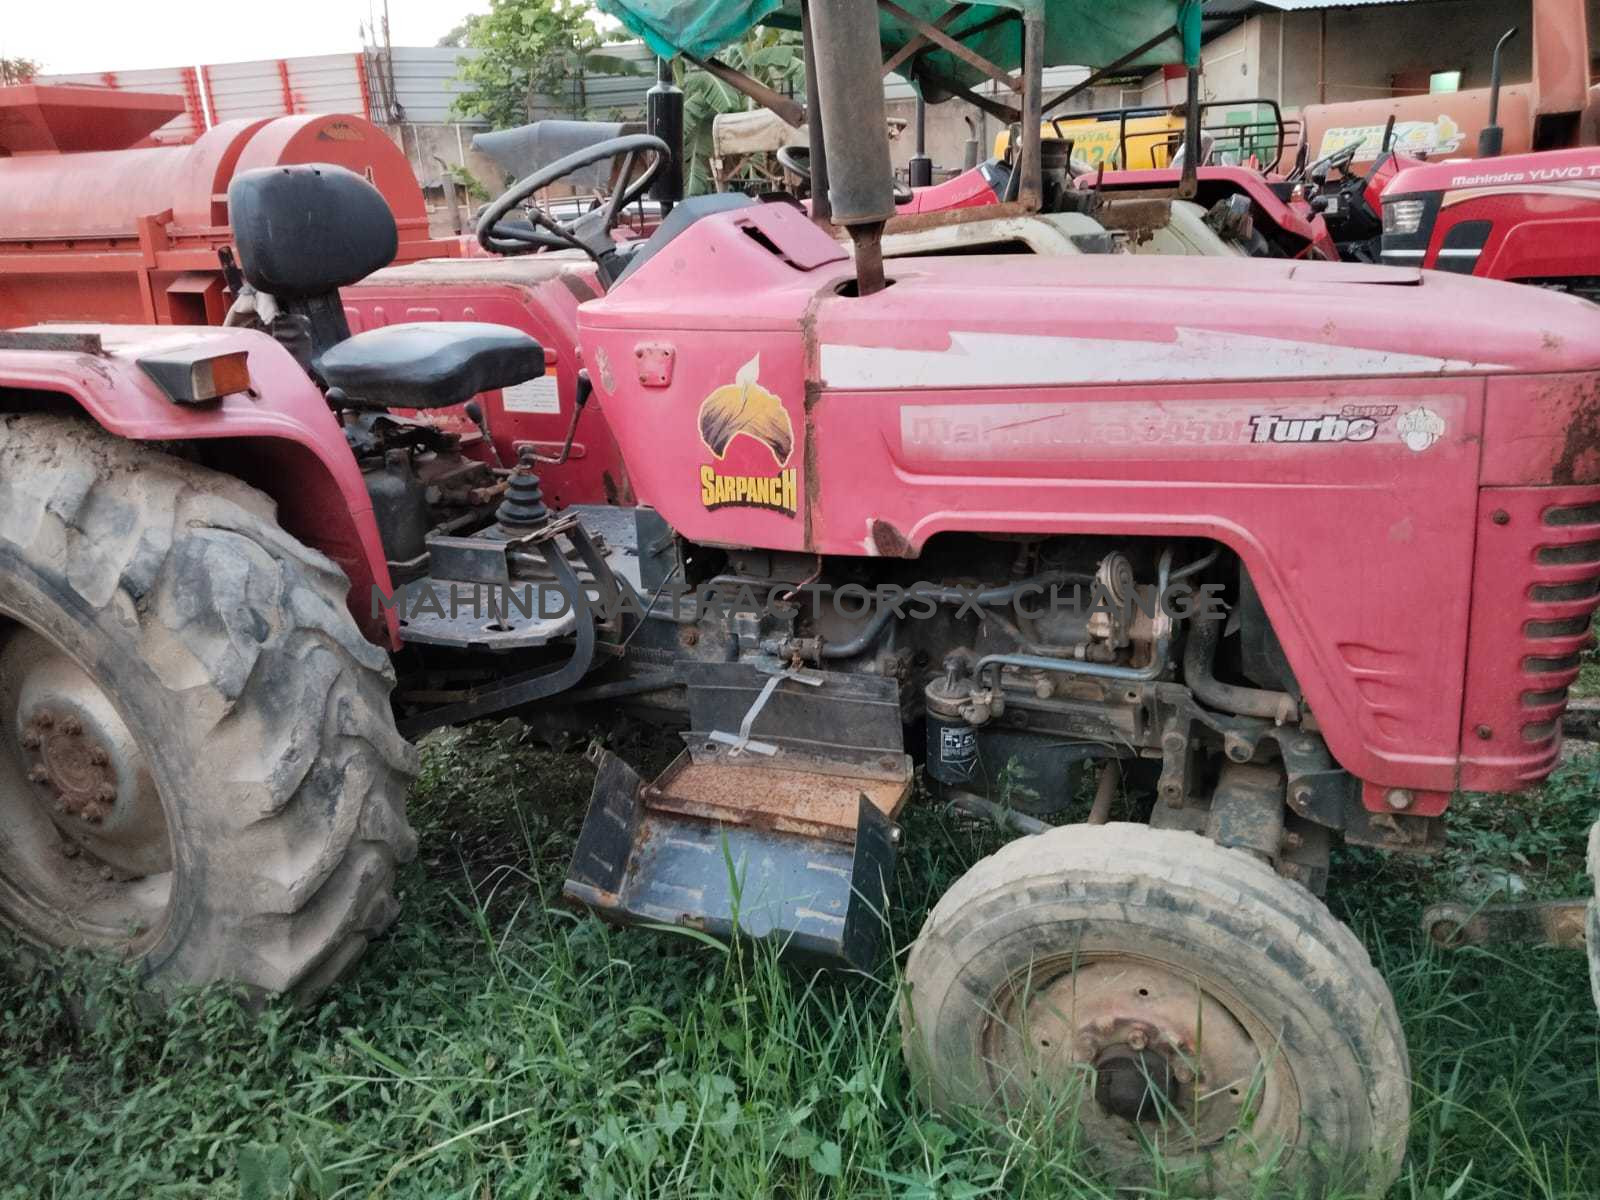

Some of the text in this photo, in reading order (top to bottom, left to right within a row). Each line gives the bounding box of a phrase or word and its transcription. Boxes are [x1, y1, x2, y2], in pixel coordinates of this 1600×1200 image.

[1452, 172, 1525, 186] Mahindra
[1529, 166, 1583, 180] YUVO
[1249, 414, 1378, 443] Turbo
[700, 464, 797, 518] SARPANCH
